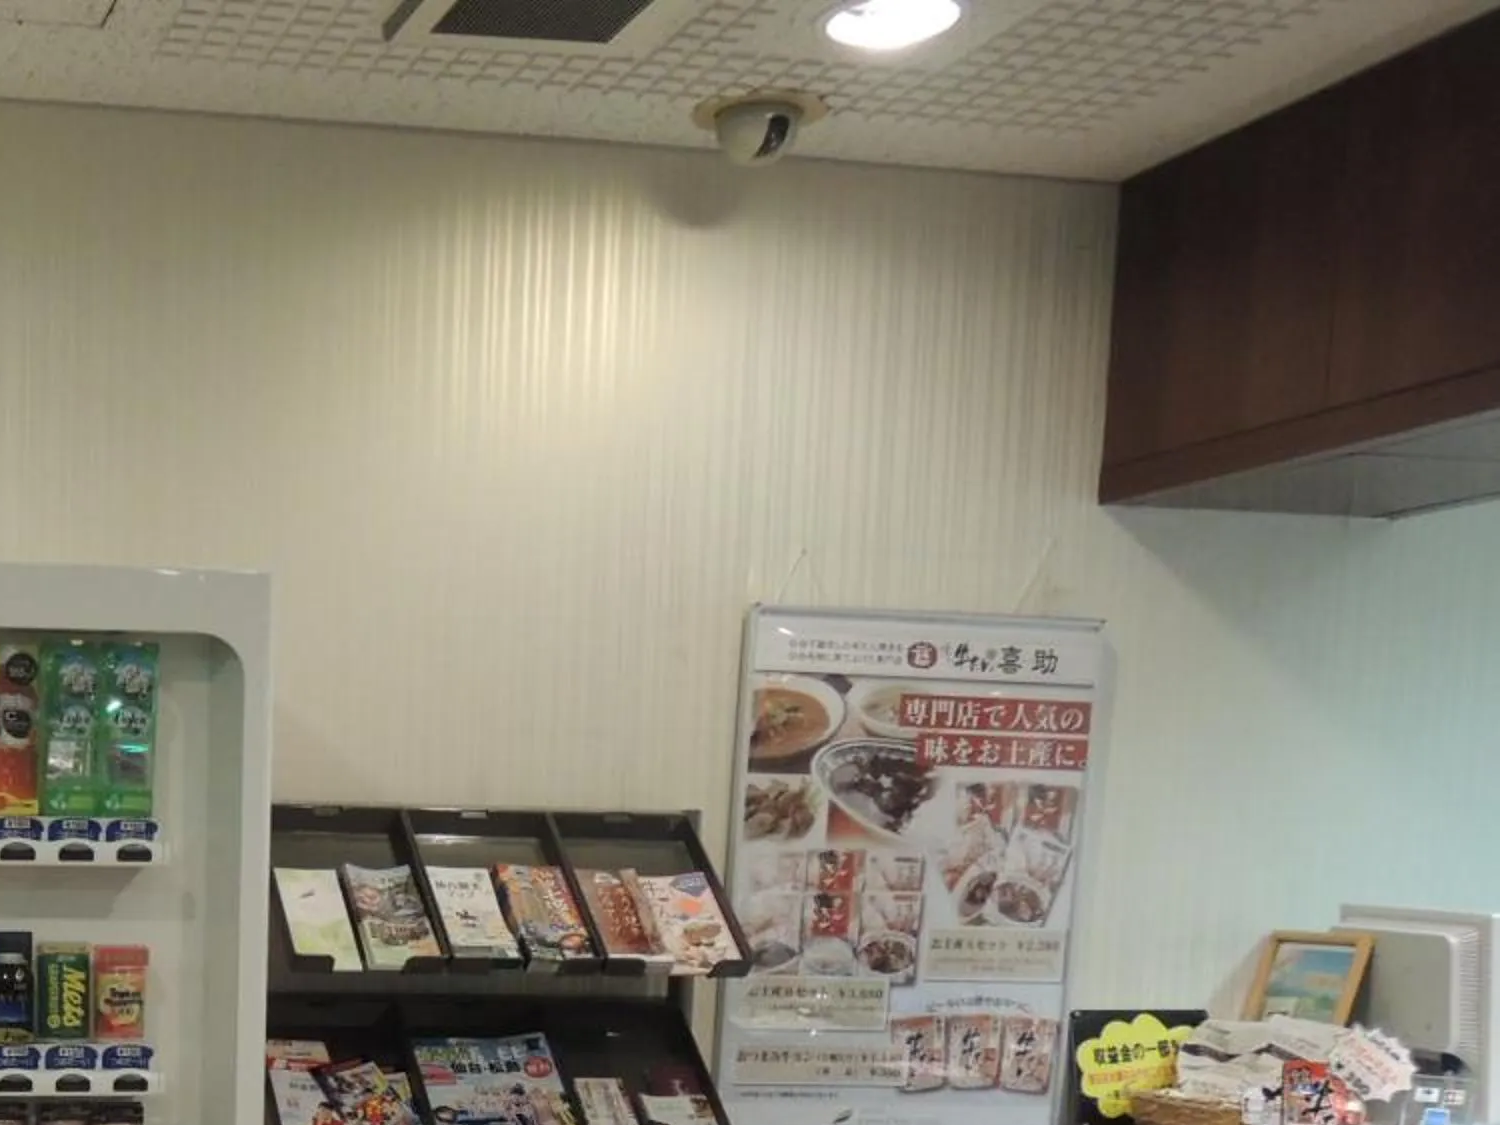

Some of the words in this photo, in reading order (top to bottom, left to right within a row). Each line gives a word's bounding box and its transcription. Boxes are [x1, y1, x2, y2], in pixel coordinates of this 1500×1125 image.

[904, 696, 1084, 733] 専門店で人気の
[63, 964, 86, 1027] Mets
